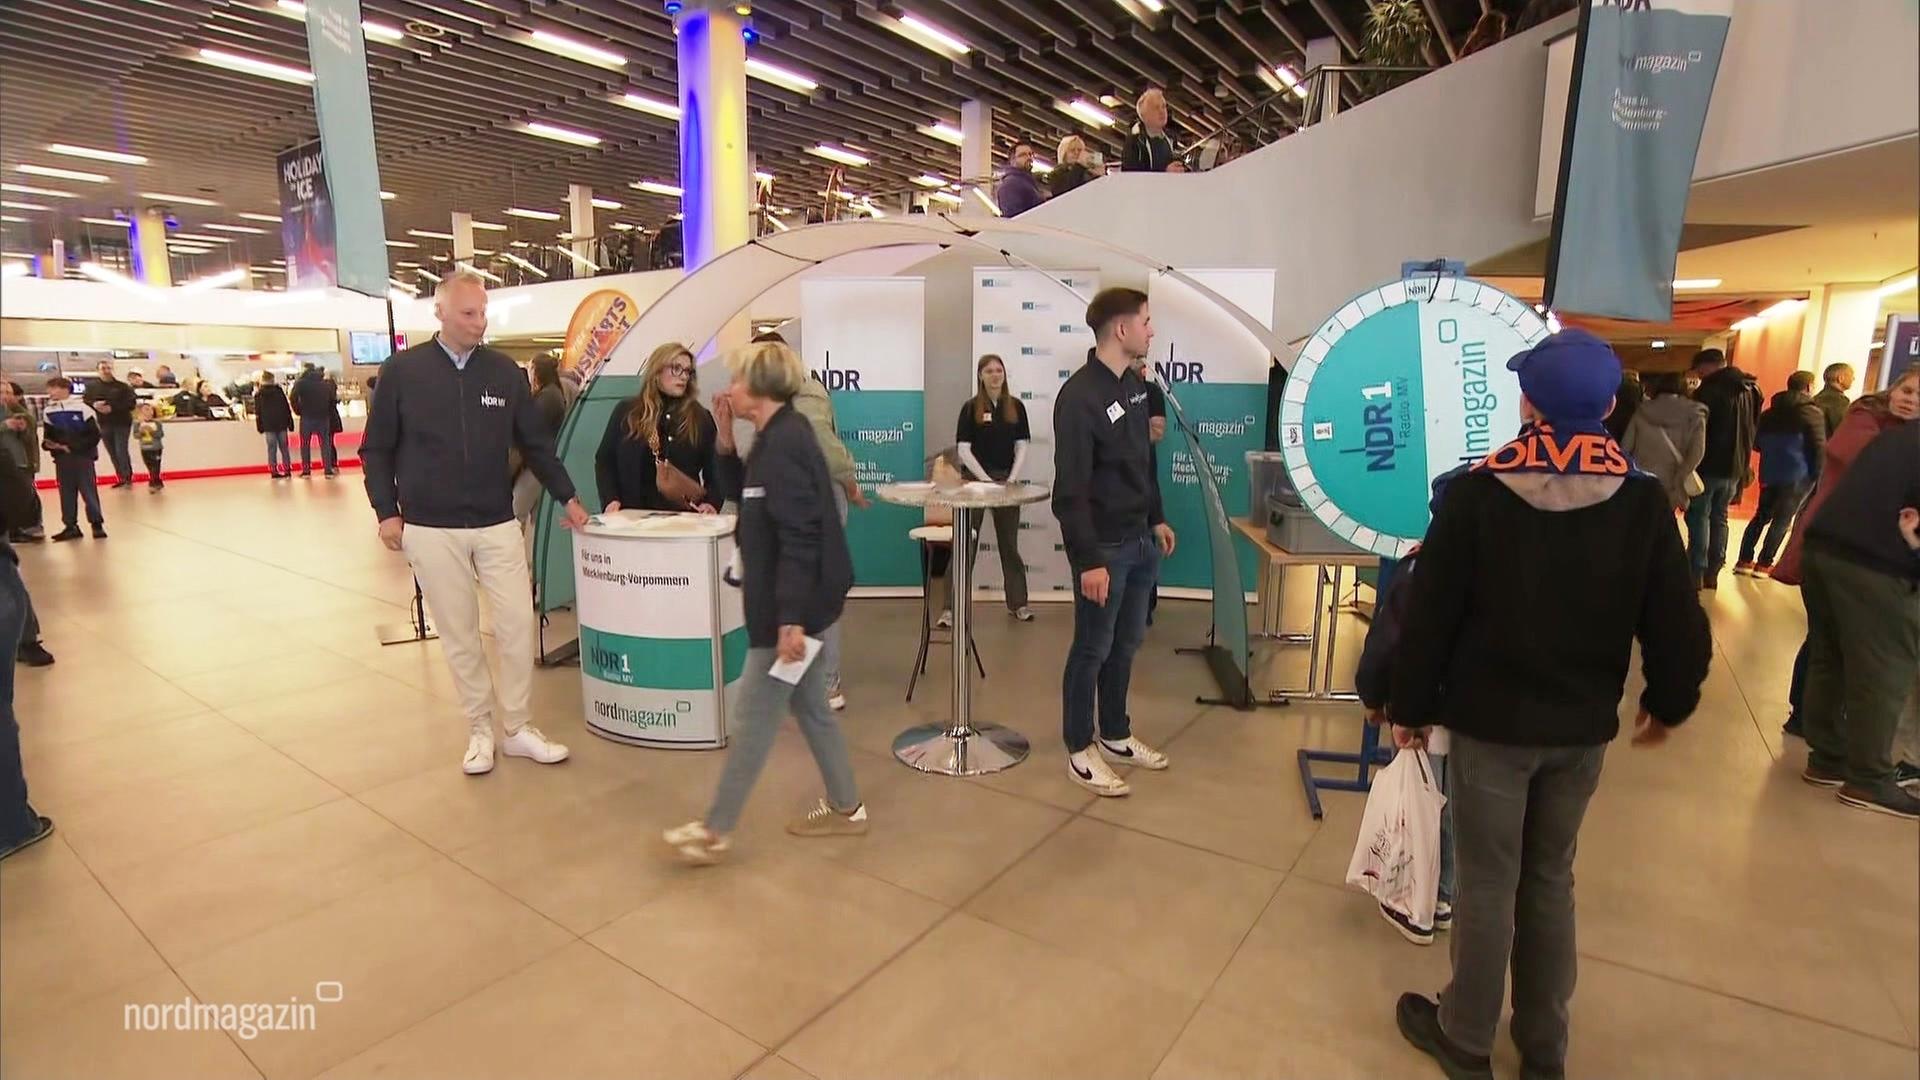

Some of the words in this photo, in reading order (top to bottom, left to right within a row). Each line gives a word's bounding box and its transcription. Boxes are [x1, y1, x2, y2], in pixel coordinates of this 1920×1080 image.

[284, 154, 321, 183] HOLIDAY
[296, 177, 314, 200] ICE
[810, 368, 861, 391] NDR
[1154, 361, 1204, 384] NDR
[1398, 404, 1412, 440] Radio
[867, 461, 878, 471] in
[1206, 452, 1216, 464] in
[603, 552, 612, 565] in
[582, 566, 690, 588] Mecklenburg-Vorpommern
[594, 700, 677, 730] nordmagazin
